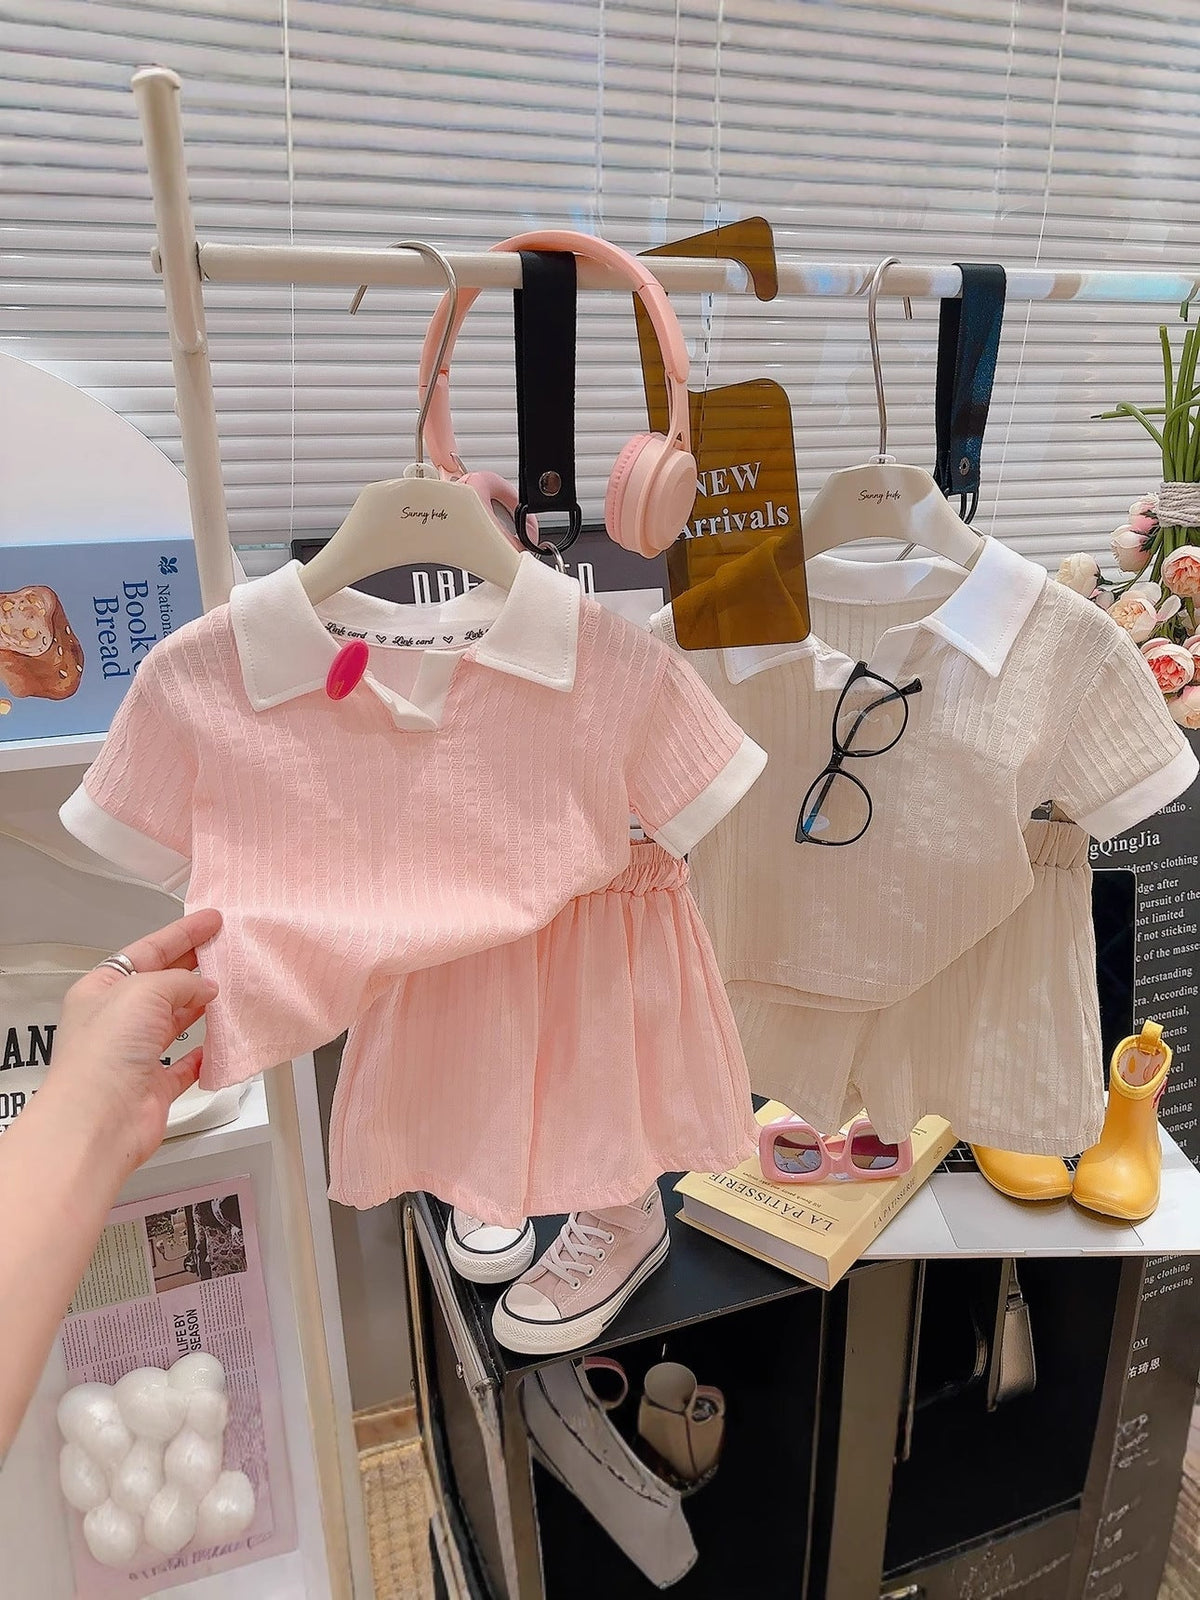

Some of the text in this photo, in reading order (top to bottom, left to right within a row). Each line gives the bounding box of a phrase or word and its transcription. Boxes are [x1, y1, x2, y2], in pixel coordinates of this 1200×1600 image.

[696, 461, 760, 497] NEW
[858, 489, 883, 505] Sunny
[400, 506, 429, 525] Sunny
[676, 501, 789, 540] Arrivals
[122, 579, 157, 654] Book
[93, 595, 130, 680] Bread
[325, 621, 346, 636] Link
[347, 630, 368, 639] card
[392, 635, 413, 647] Link
[415, 637, 435, 646] card
[1160, 855, 1199, 869] clothing
[1157, 879, 1179, 890] after
[1140, 890, 1200, 912] pursuit of the
[1152, 908, 1185, 924] limited
[1143, 930, 1159, 941] not
[1161, 923, 1198, 939] sticking
[1143, 949, 1156, 961] of
[1156, 948, 1171, 959] the
[1152, 985, 1199, 1003] According
[1176, 1043, 1191, 1054] but
[1167, 1077, 1198, 1093] match!
[1157, 1102, 1193, 1118] clothing
[709, 1173, 833, 1232] LA PÂTISSERIE
[1156, 1262, 1191, 1280] clothing
[1160, 1276, 1194, 1295] dressing
[173, 1314, 186, 1329] BY
[186, 1308, 202, 1351] SEASON
[175, 1329, 189, 1352] LIFE
